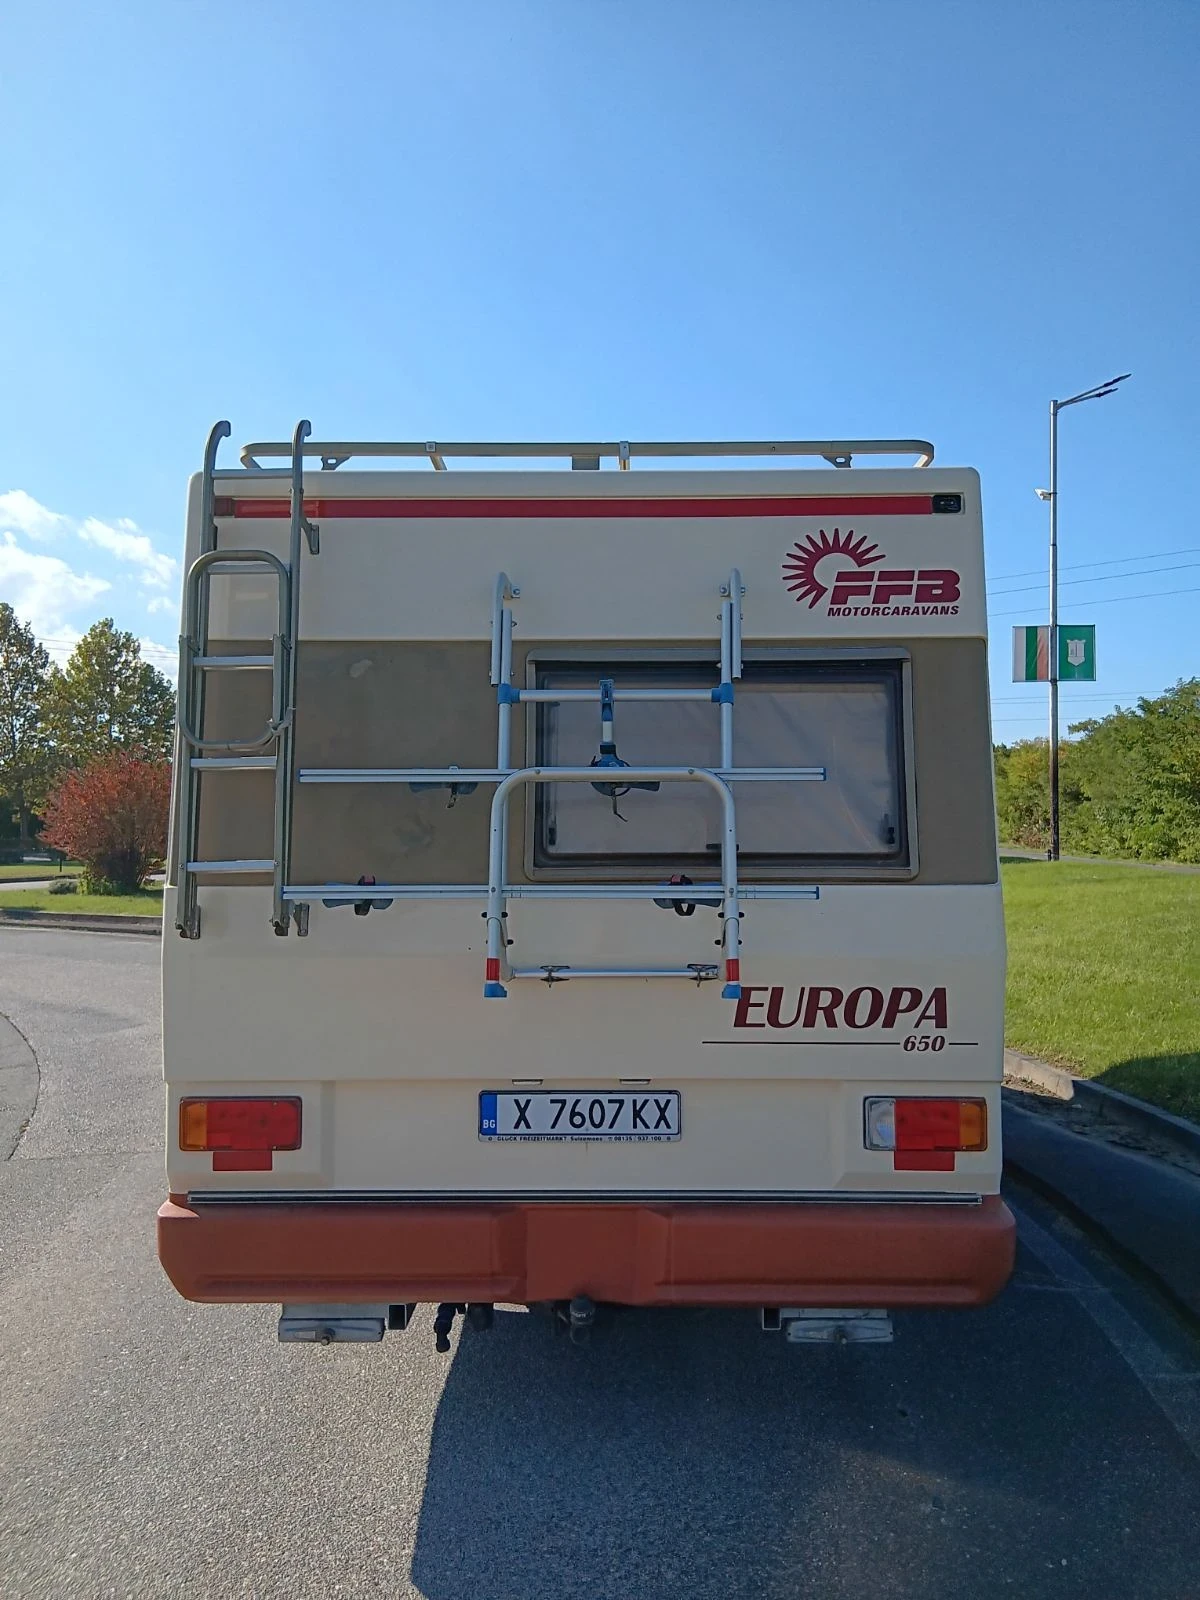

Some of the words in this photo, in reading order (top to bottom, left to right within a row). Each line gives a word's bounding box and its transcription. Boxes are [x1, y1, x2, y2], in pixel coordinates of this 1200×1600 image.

[830, 570, 960, 605] FFB
[827, 605, 959, 617] MOTORCARAVANS
[733, 986, 948, 1029] EUROPA
[903, 1035, 945, 1052] 650
[483, 1119, 496, 1129] BG
[513, 1098, 532, 1130] X
